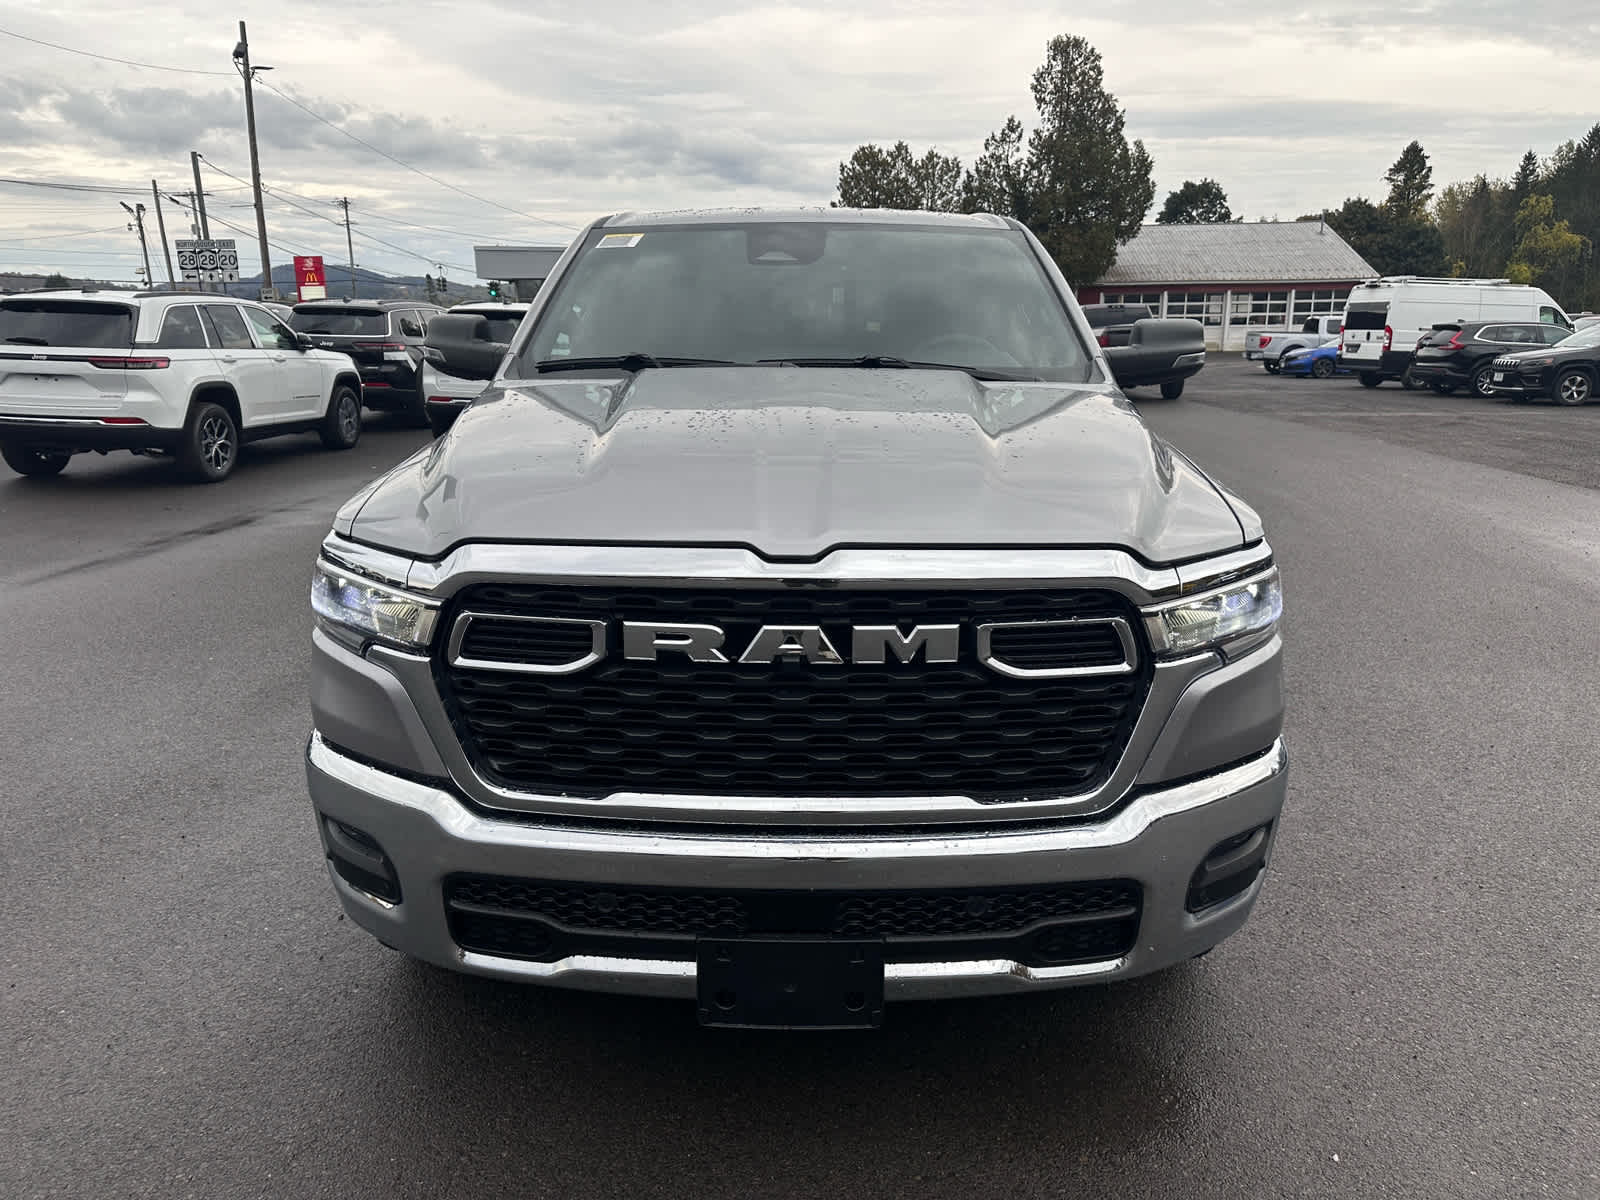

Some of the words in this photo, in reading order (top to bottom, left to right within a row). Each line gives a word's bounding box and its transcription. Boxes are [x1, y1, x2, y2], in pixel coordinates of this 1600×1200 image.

[180, 254, 195, 265] 28
[200, 254, 215, 265] 28
[220, 254, 236, 265] 20
[623, 621, 961, 665] RAM
